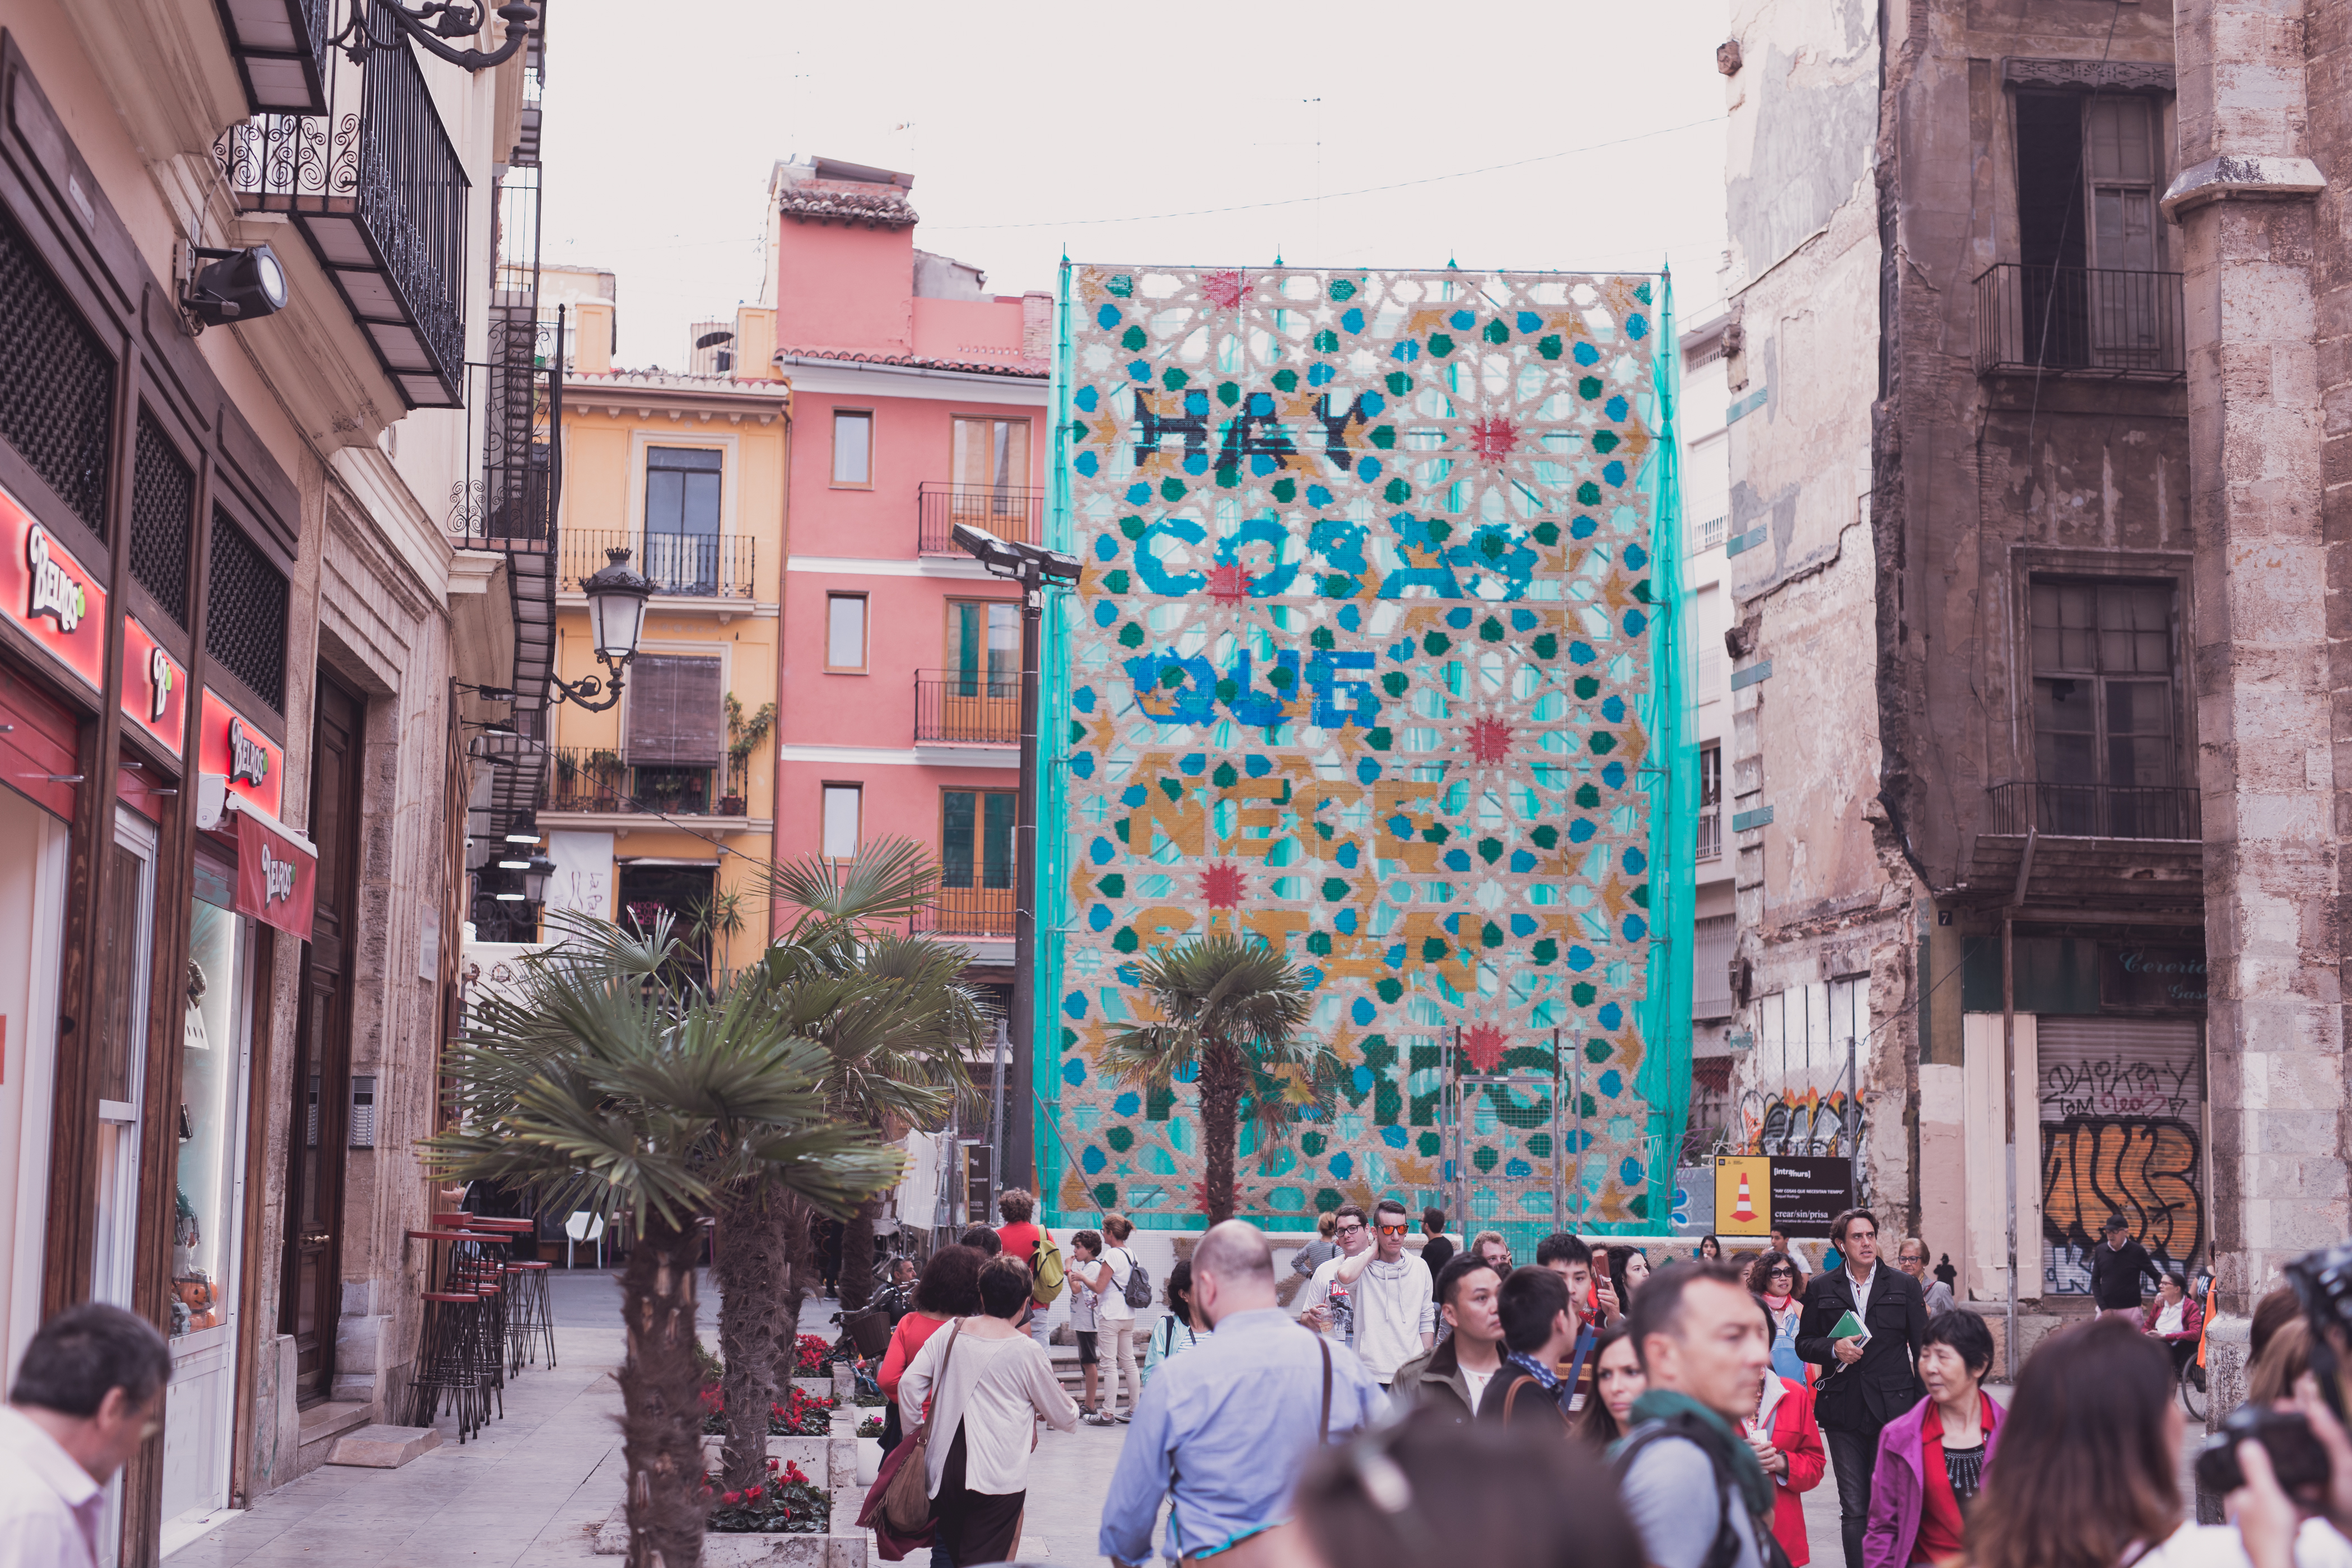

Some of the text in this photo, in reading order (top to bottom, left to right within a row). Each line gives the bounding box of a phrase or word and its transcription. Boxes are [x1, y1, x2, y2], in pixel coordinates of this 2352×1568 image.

[30, 525, 79, 631] BELROS
[232, 717, 263, 784] BELROS
[262, 843, 292, 903] BELROS
[1942, 912, 1949, 925] 7
